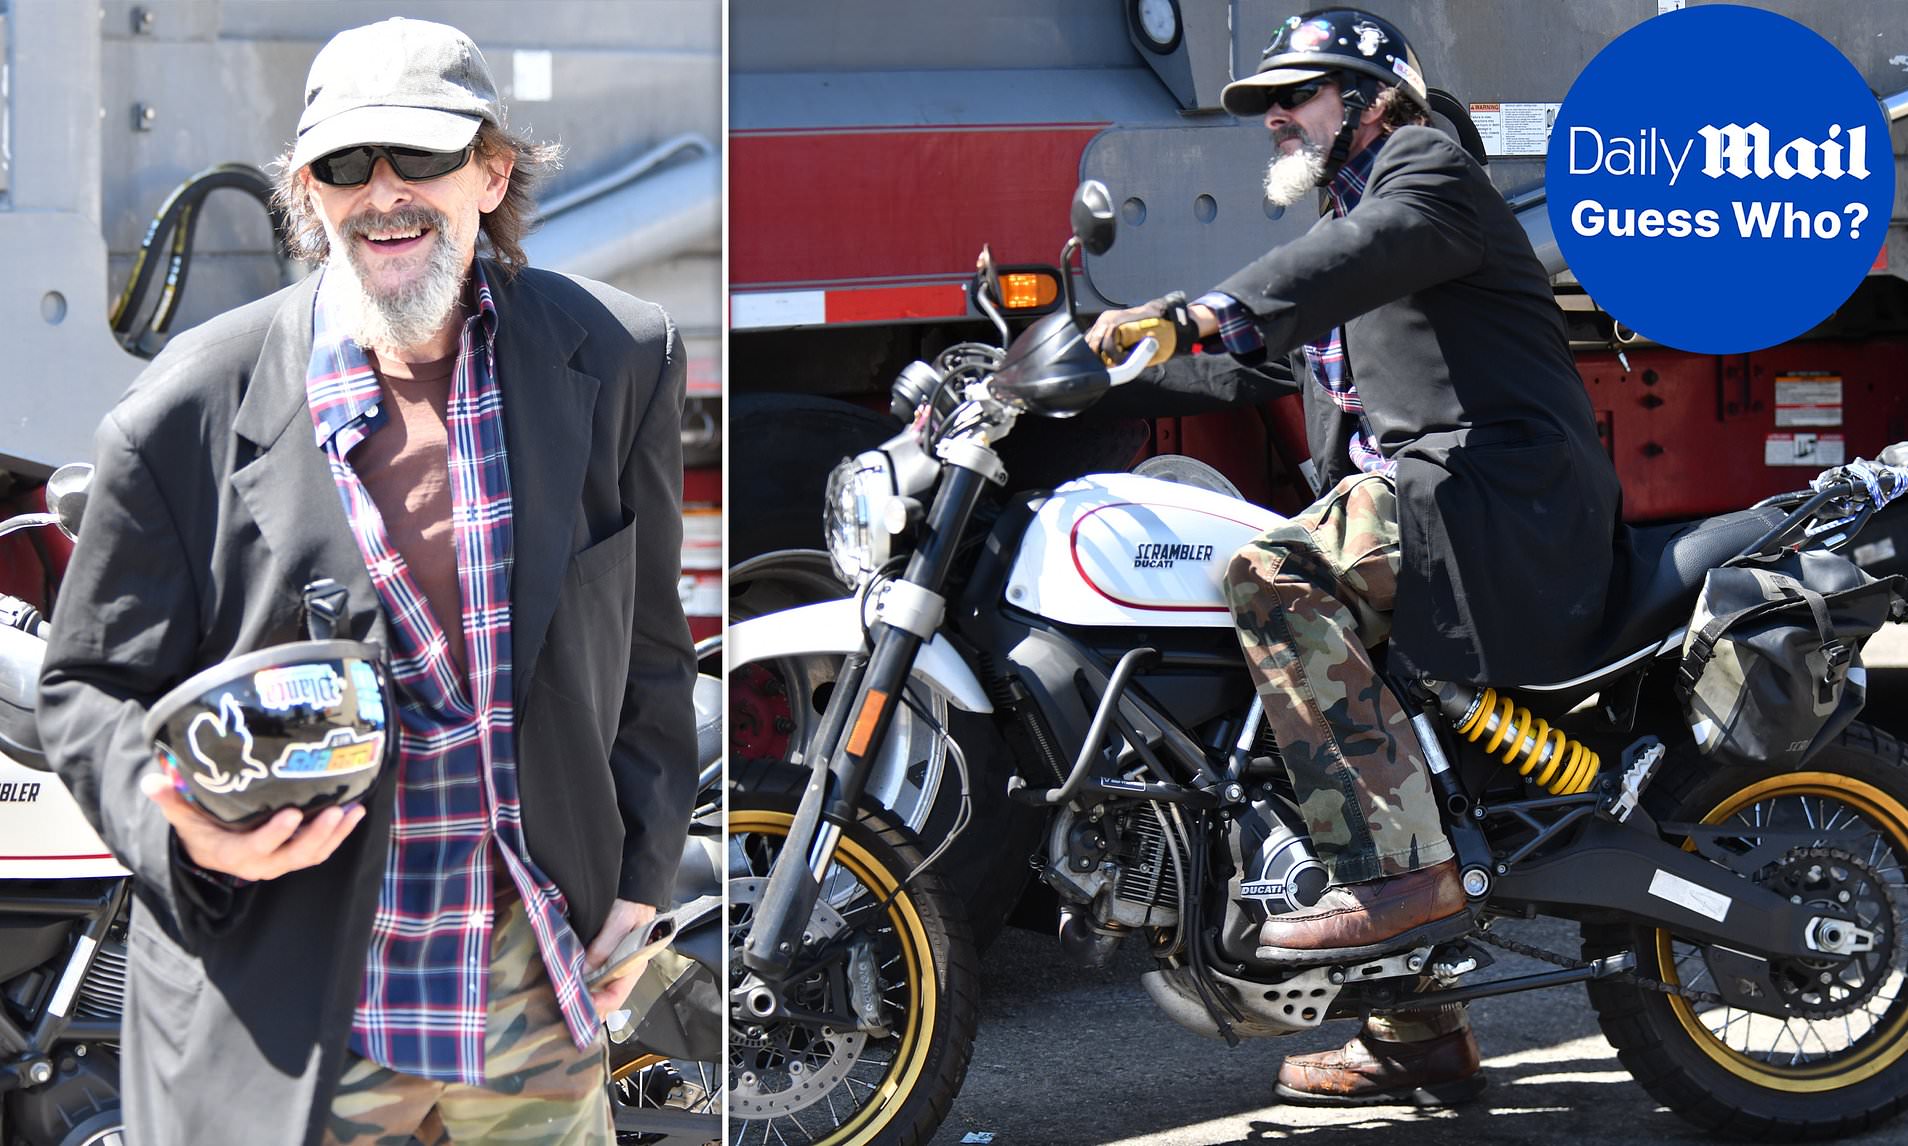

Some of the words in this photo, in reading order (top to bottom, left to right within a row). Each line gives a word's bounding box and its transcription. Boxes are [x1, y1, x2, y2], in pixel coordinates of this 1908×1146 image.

[1135, 544, 1213, 561] SCRAMBLER
[1134, 560, 1174, 568] DUCATI
[0, 782, 41, 802] BLER
[1241, 885, 1282, 895] DUCATI
